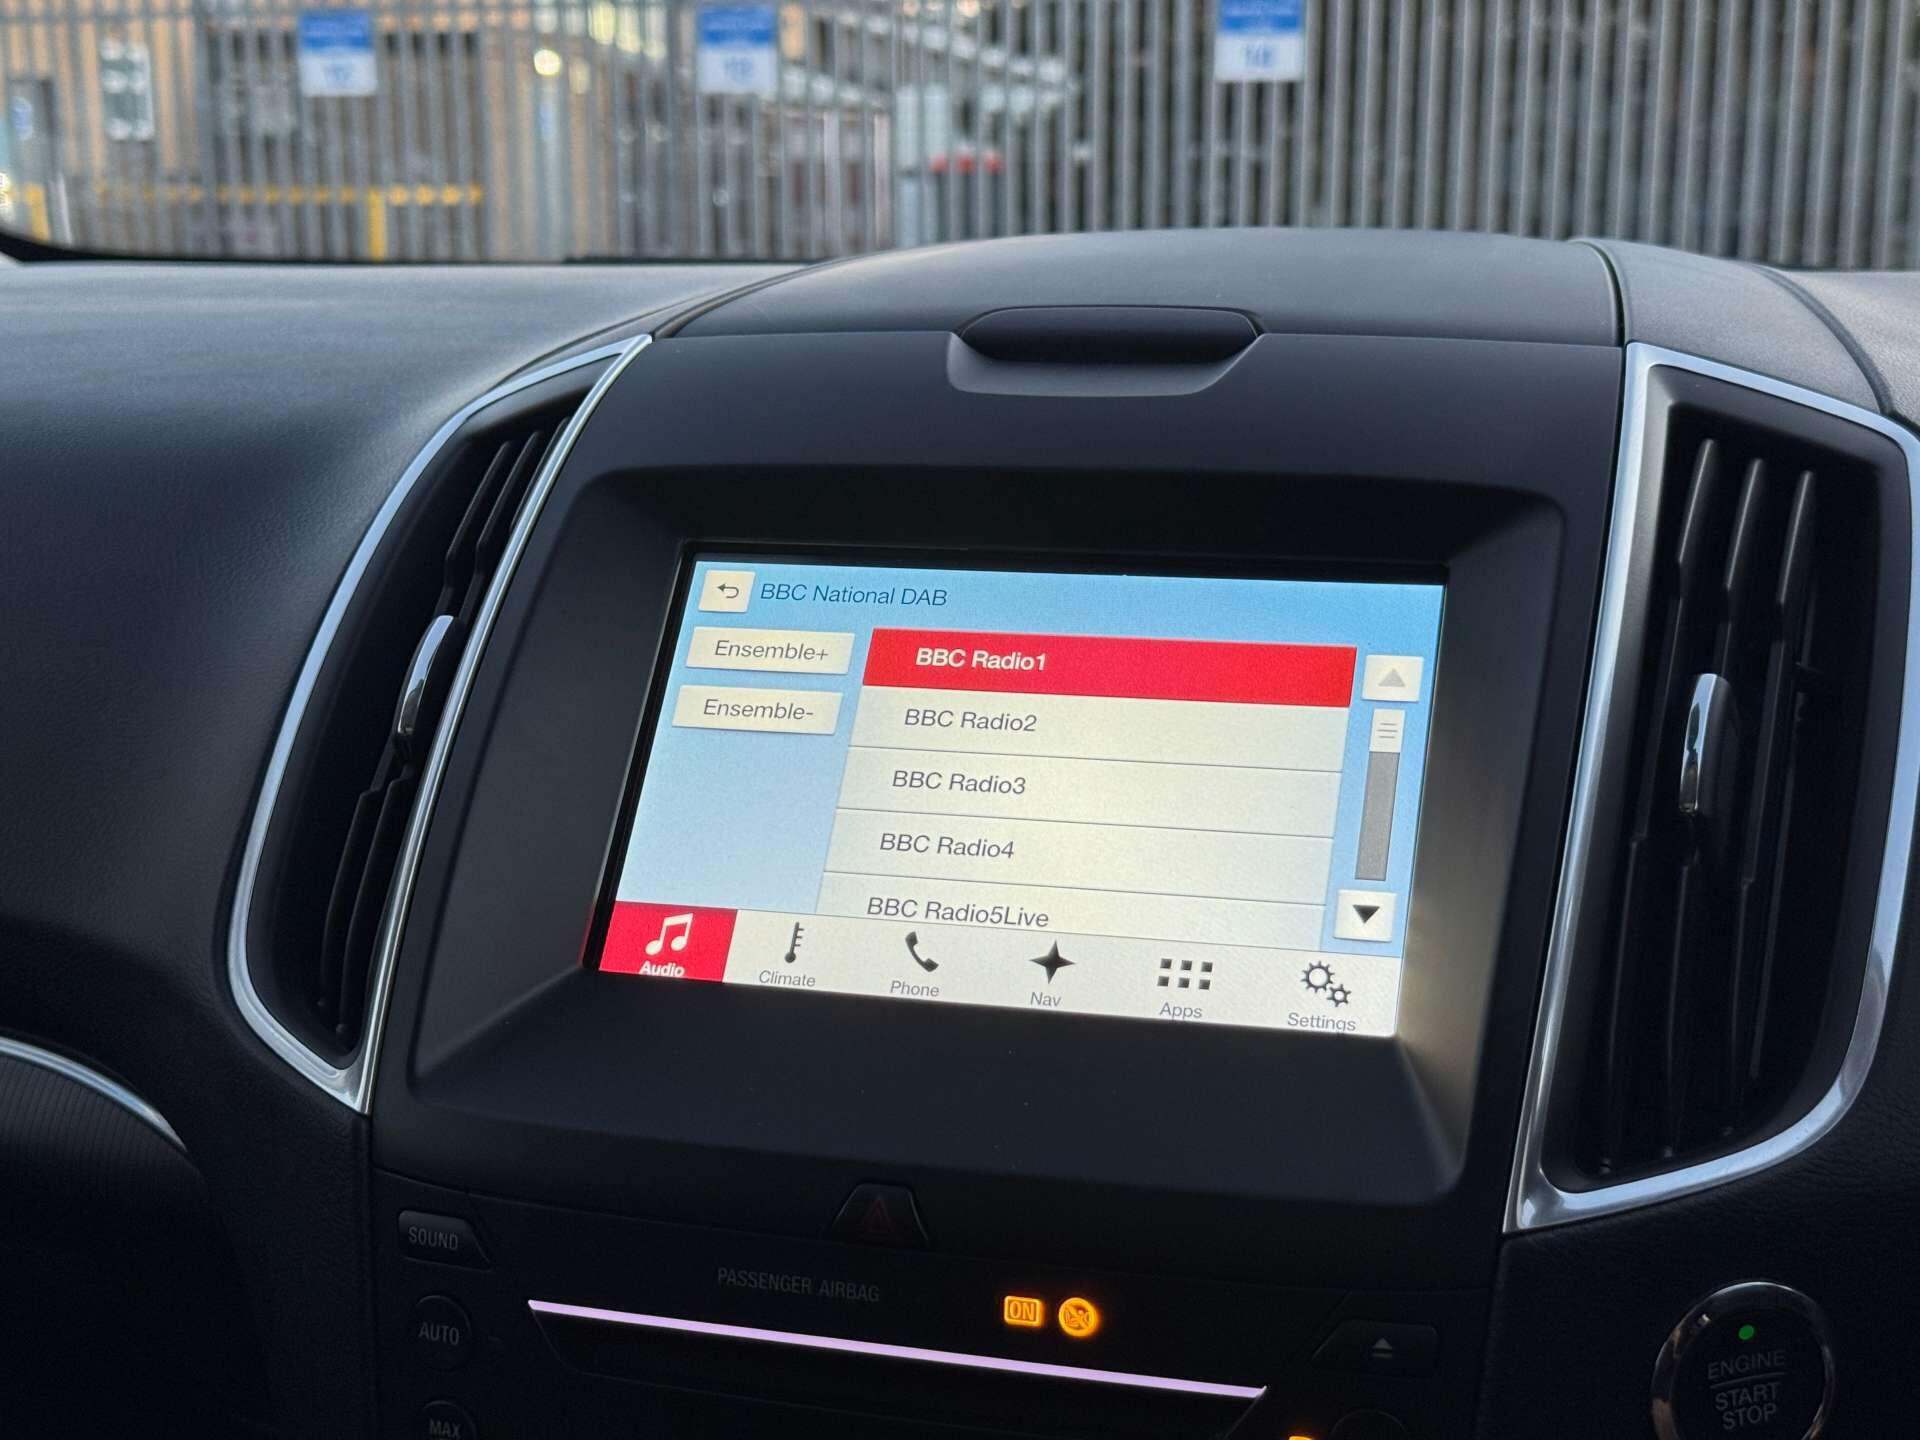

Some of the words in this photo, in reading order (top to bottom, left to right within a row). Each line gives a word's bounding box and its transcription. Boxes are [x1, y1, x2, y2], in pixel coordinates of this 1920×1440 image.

[760, 583, 807, 601] BBC
[813, 584, 896, 604] National
[901, 588, 948, 607] DAB
[714, 639, 829, 662] Ensemble+
[915, 647, 966, 668] BBC
[971, 650, 1047, 672] Radio1
[703, 698, 814, 721] Ensemble-
[904, 708, 954, 728] BBC
[960, 711, 1038, 733] Radio2
[892, 770, 943, 790] BBC
[949, 773, 1027, 796] Radio3
[879, 832, 931, 853] BBC
[936, 836, 1015, 859] Radio4
[867, 896, 919, 918] BBC
[925, 901, 1050, 928] Radio5Live
[638, 960, 685, 977] Audio
[758, 970, 817, 988] Climate
[889, 980, 940, 998] Phone
[1030, 991, 1063, 1008] Nav
[1159, 1002, 1203, 1020] Apps
[1287, 1011, 1357, 1032] Settings
[407, 1225, 460, 1251] SOUND
[717, 1266, 814, 1296] PASSENGER
[818, 1279, 881, 1303] AIRBAG
[1009, 1300, 1037, 1321] ON
[417, 1321, 462, 1347] AUTO
[1707, 1350, 1785, 1380] ENGINE
[1714, 1381, 1781, 1412] START
[427, 1416, 463, 1440] MAX
[1722, 1401, 1777, 1431] STOP
